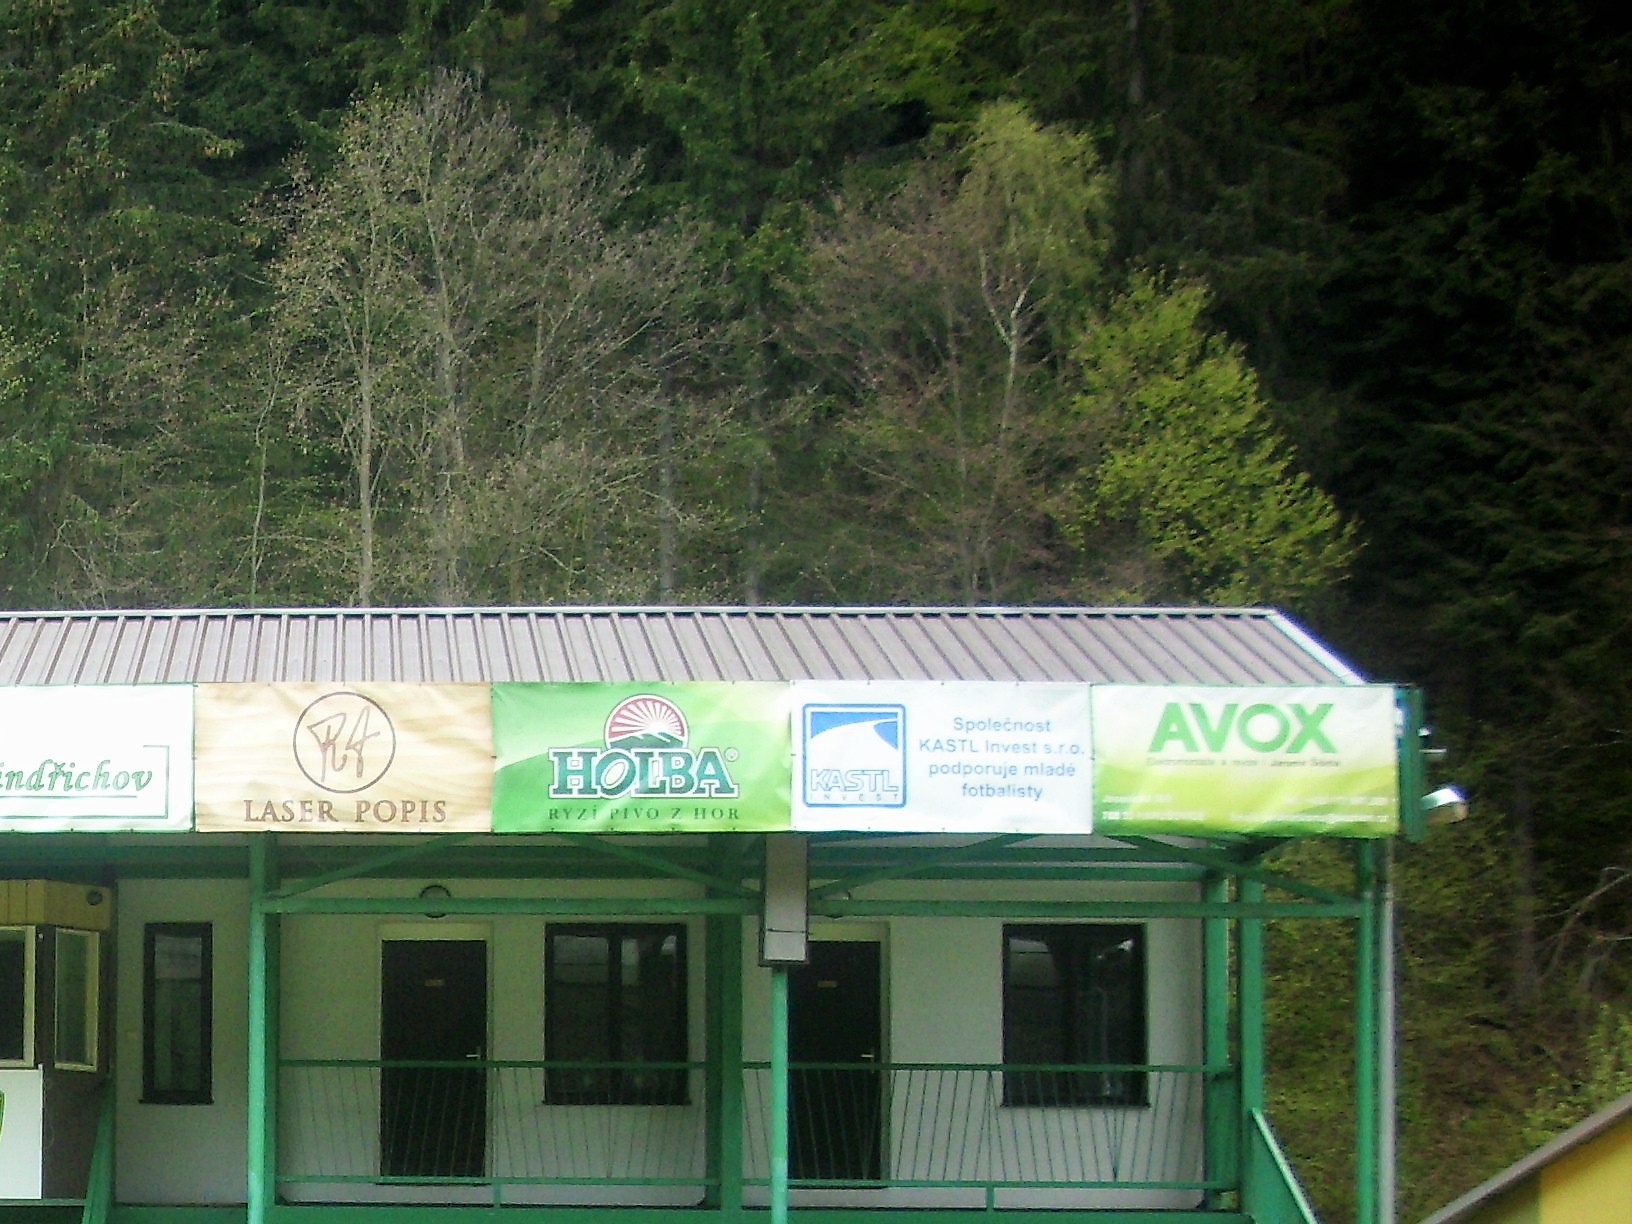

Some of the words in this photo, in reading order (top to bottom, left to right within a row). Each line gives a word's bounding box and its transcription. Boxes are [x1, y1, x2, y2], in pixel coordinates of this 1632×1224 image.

[952, 716, 1052, 733] Společnost
[1147, 701, 1338, 754] AVOX
[919, 738, 979, 753] KASTL
[985, 739, 1037, 754] Invest
[1043, 743, 1085, 755] s.r.o.
[550, 748, 739, 798] HOLBA
[929, 761, 1018, 778] podporuje
[1024, 762, 1076, 777] mladé
[810, 768, 899, 792] KASTL
[962, 782, 1043, 801] fotbalisty
[243, 799, 339, 823] LASER
[355, 799, 447, 823] POPIS
[548, 804, 597, 820] RYZÍ
[610, 807, 660, 820] PIVO
[671, 807, 682, 820] Z
[693, 807, 740, 820] HOR
